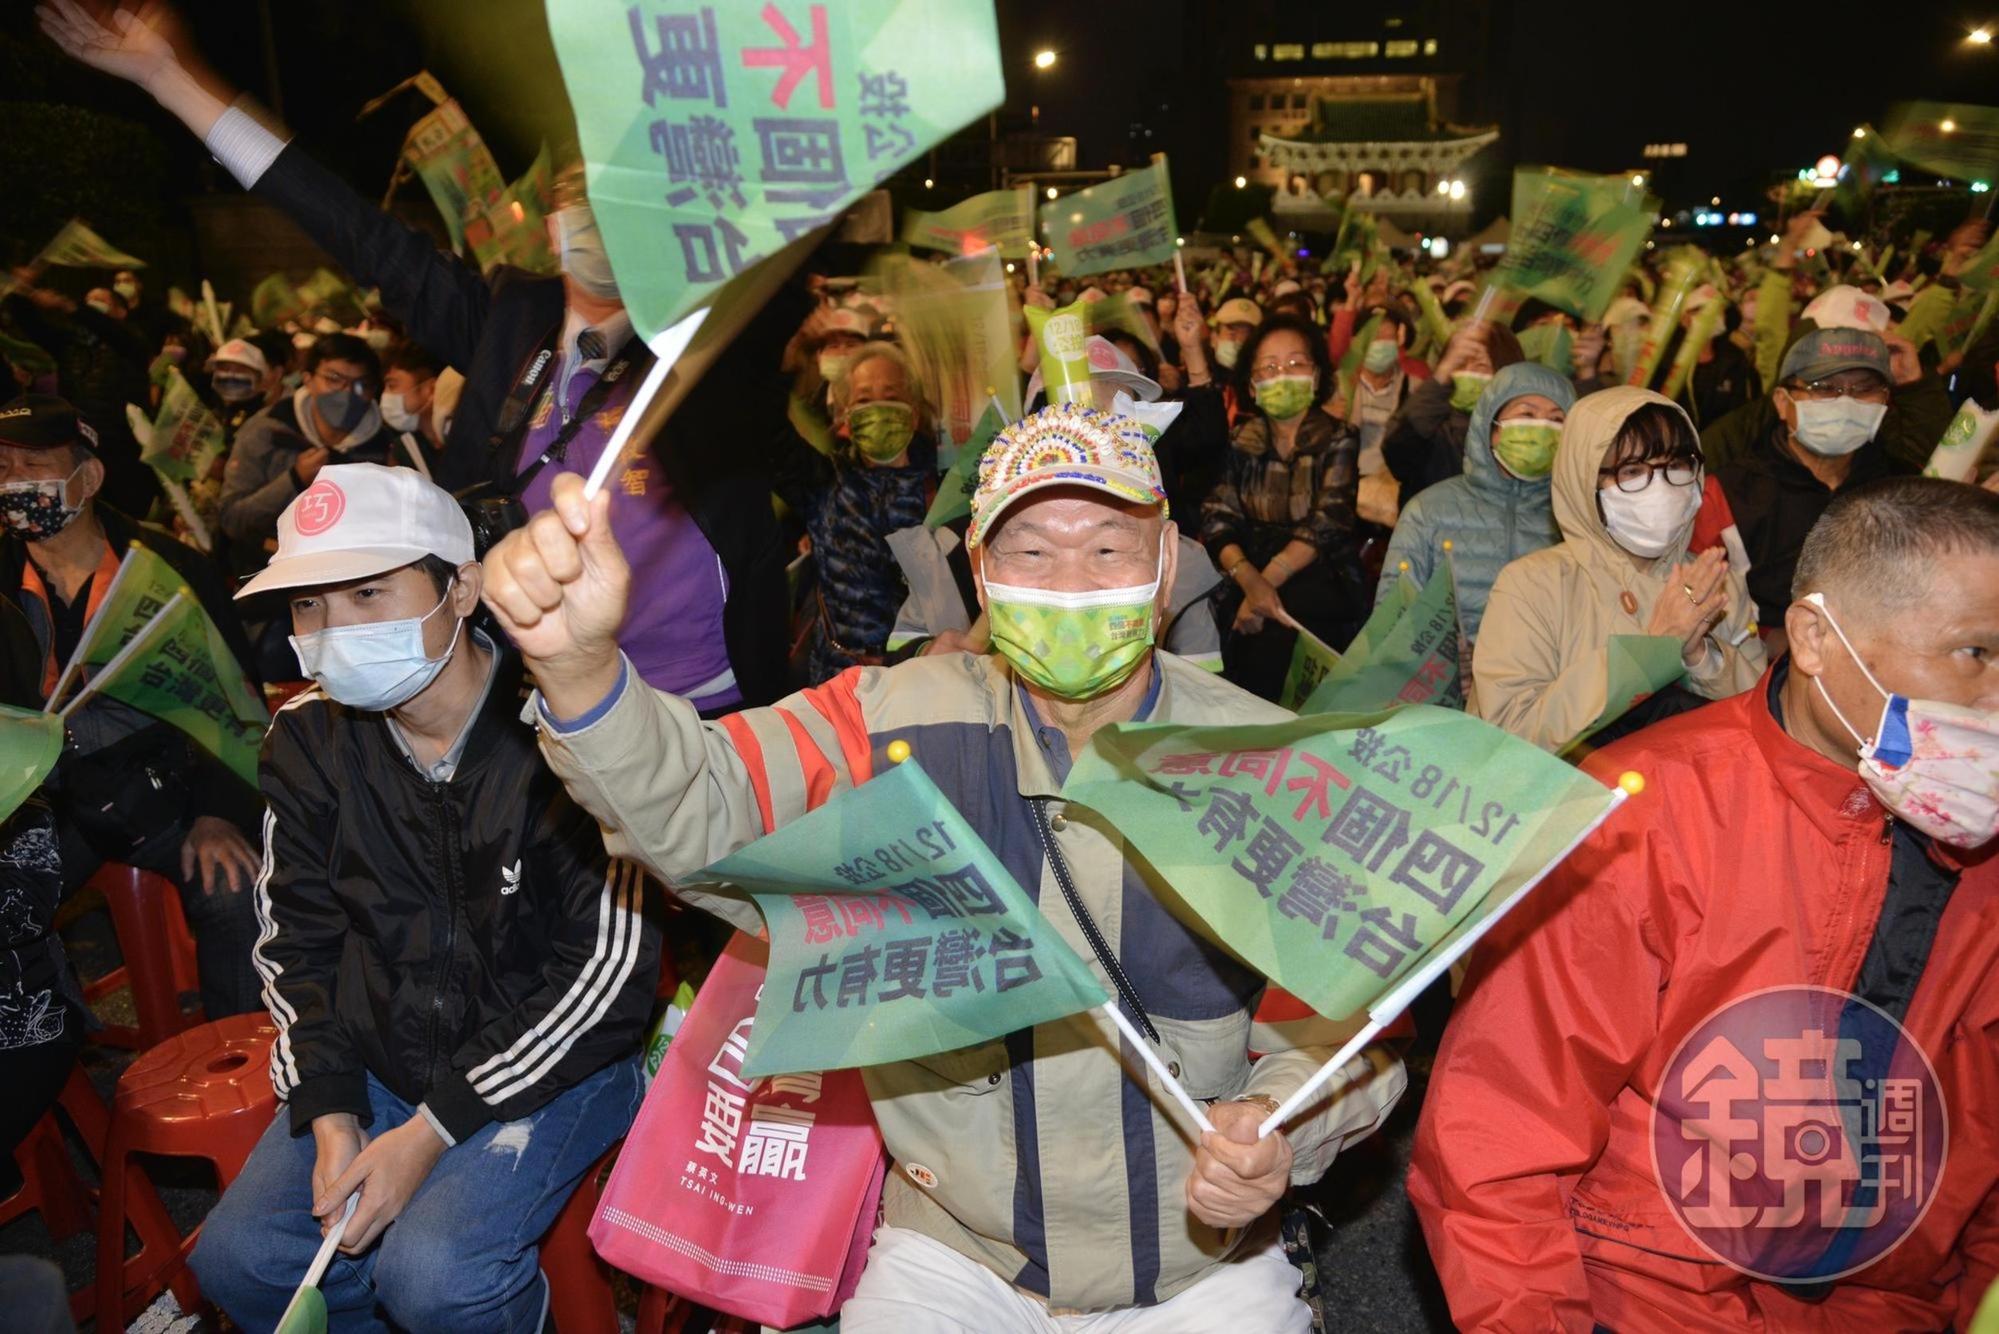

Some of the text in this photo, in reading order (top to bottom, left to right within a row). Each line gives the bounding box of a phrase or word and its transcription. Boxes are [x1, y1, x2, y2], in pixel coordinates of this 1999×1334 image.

[522, 349, 551, 385] Canon
[685, 1160, 719, 1185] 蔡英文
[680, 1175, 754, 1216] TSAI ING-WEN
